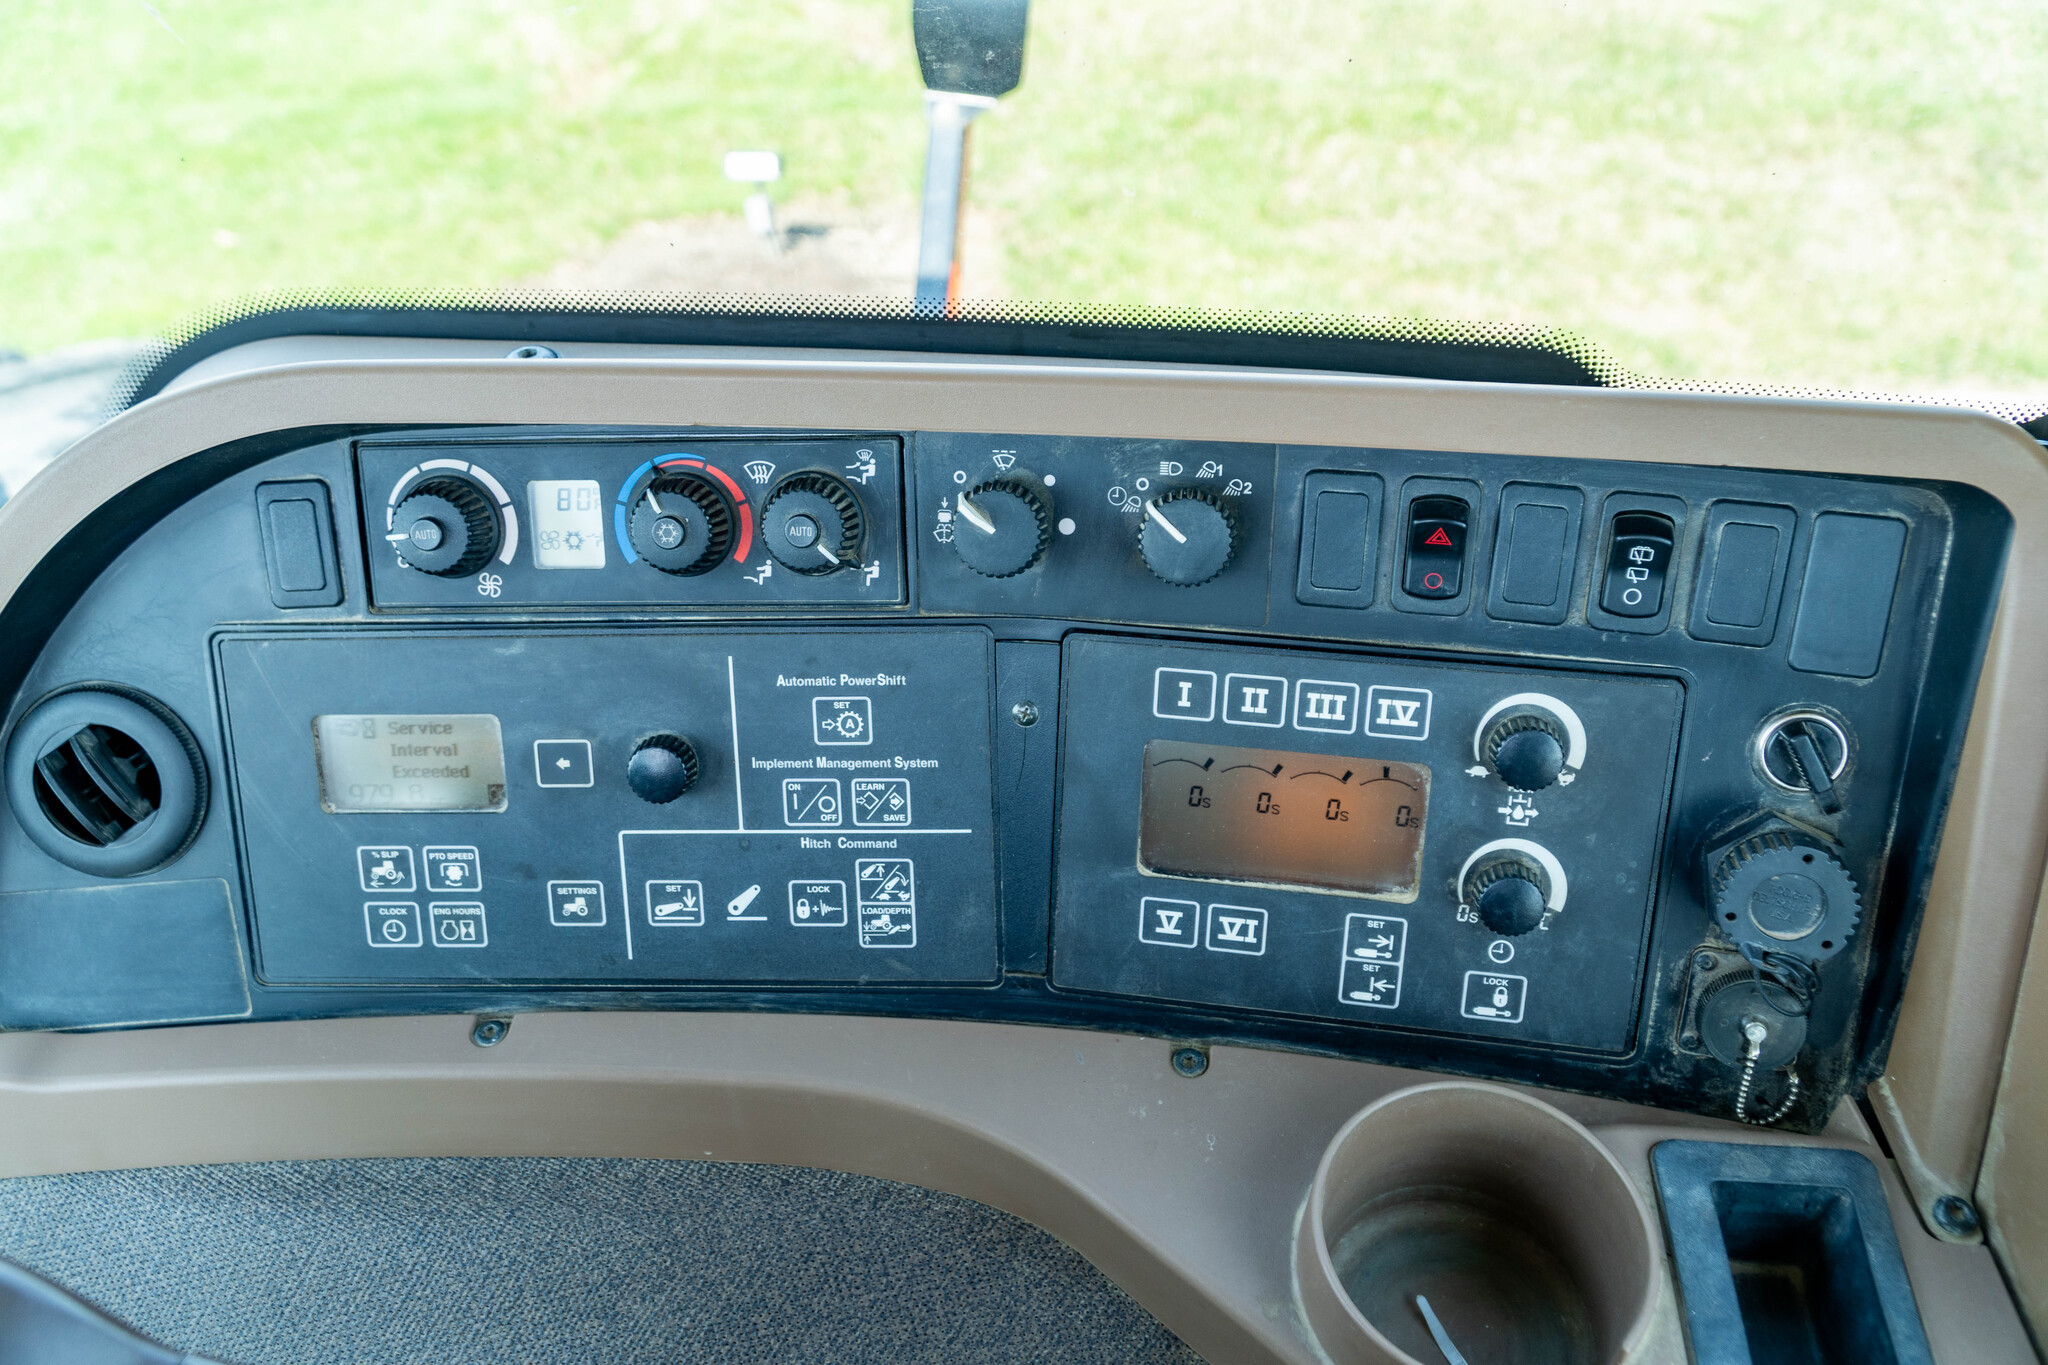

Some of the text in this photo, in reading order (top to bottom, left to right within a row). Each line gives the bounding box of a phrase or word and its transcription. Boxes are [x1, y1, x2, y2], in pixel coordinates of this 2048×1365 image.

[1243, 482, 1252, 494] 2
[414, 529, 438, 541] AUTO
[789, 526, 812, 537] AUTO
[776, 673, 907, 687] Automatic PowerShift
[1177, 681, 1192, 708] I
[1241, 686, 1269, 714] II
[833, 701, 850, 709] SET
[1305, 692, 1347, 721] III
[1376, 698, 1421, 727] IV
[388, 721, 454, 735] Service
[391, 743, 459, 757] Interval
[752, 756, 939, 770] Implement Management System
[393, 765, 471, 779] Exceeded
[788, 783, 801, 791] ON
[856, 783, 885, 791] LEARN
[820, 814, 838, 822] OFF
[883, 814, 906, 822] SAVE
[801, 836, 898, 849] Hitch Command
[371, 851, 380, 859] %
[429, 853, 474, 861] PTO SPEED
[557, 887, 597, 895] SETTINGS
[665, 885, 682, 893] SET
[807, 885, 830, 893] LOCK
[862, 907, 912, 915] LOAD/DEPTH
[1155, 909, 1184, 936] V
[1367, 921, 1385, 930] SET
[1217, 915, 1259, 944] VI
[1362, 964, 1380, 973] SET
[1483, 977, 1509, 988] LOCK
